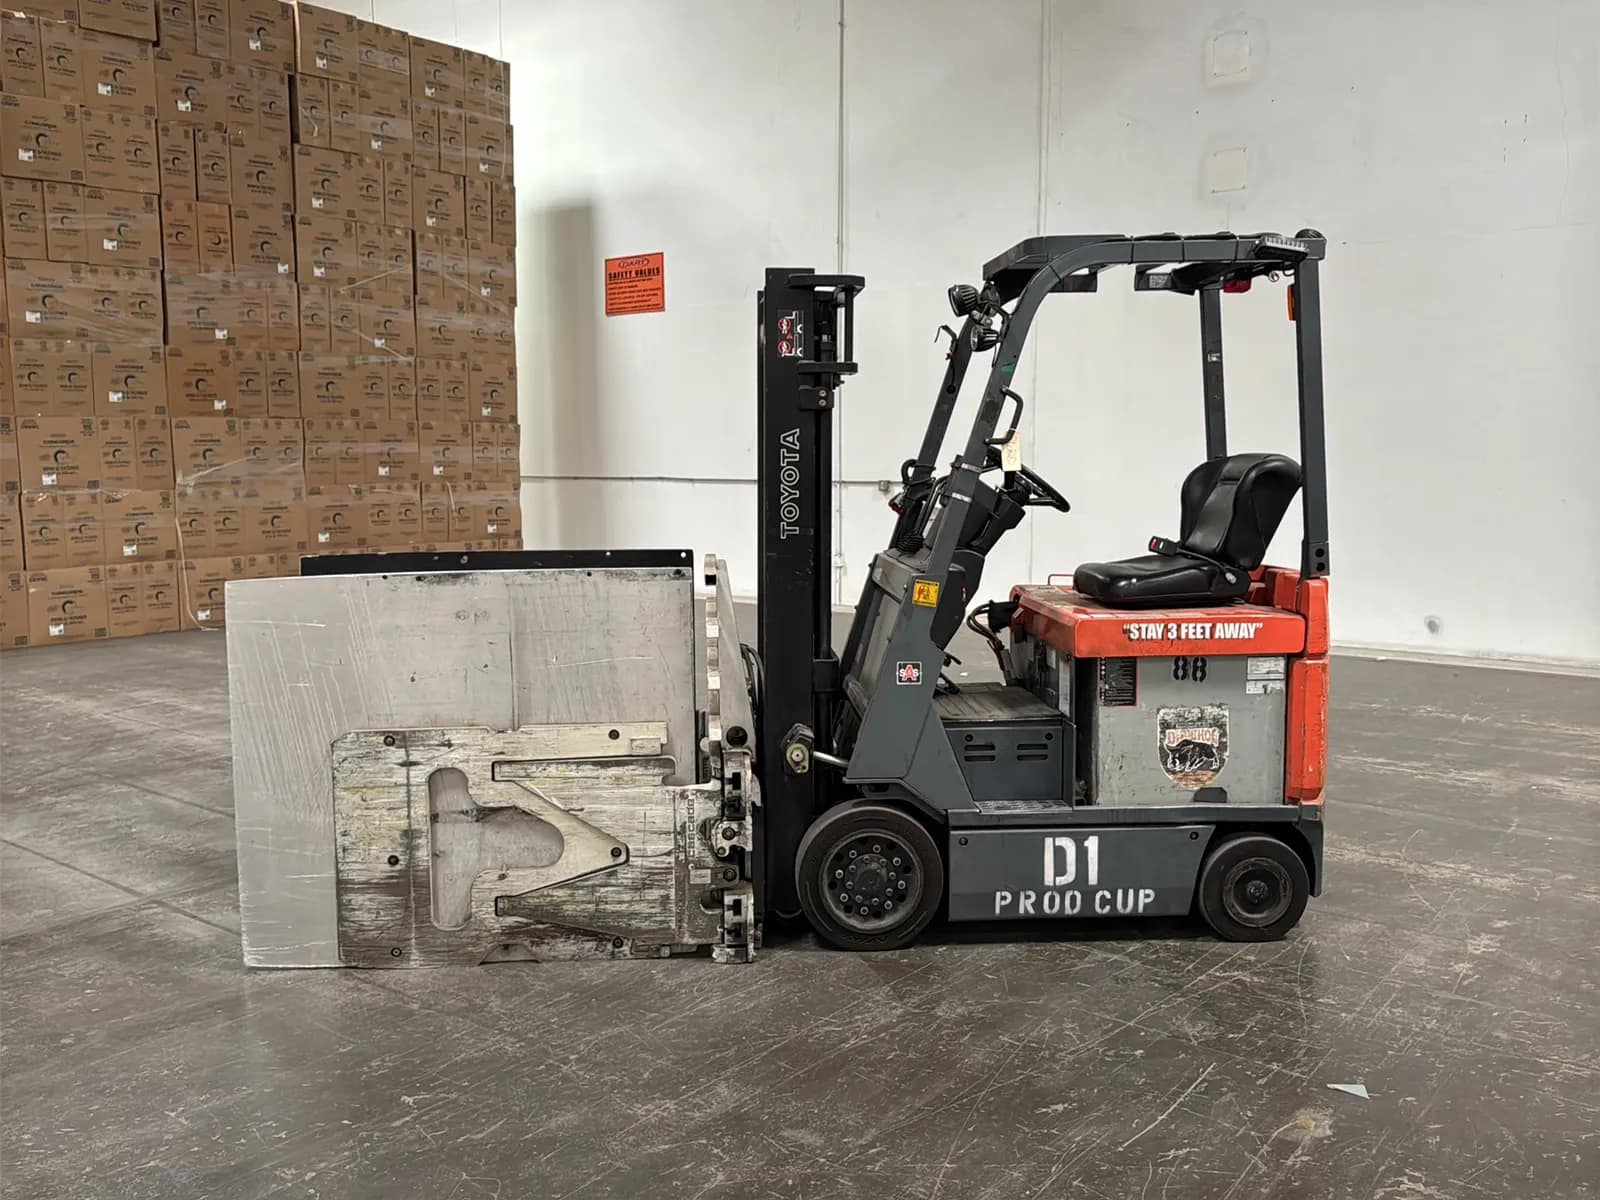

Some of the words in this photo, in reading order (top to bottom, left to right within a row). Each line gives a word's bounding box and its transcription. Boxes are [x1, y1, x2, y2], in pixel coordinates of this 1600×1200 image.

[608, 271, 632, 281] SAFETY
[635, 267, 660, 277] VALUES
[780, 428, 800, 540] TOYOTA
[1167, 623, 1178, 640] 3
[1180, 622, 1213, 640] FEET
[898, 664, 920, 681] SAS
[1173, 656, 1208, 682] 88
[1043, 835, 1100, 887] D1
[994, 889, 1083, 916] PROD
[1094, 888, 1156, 915] CUP
